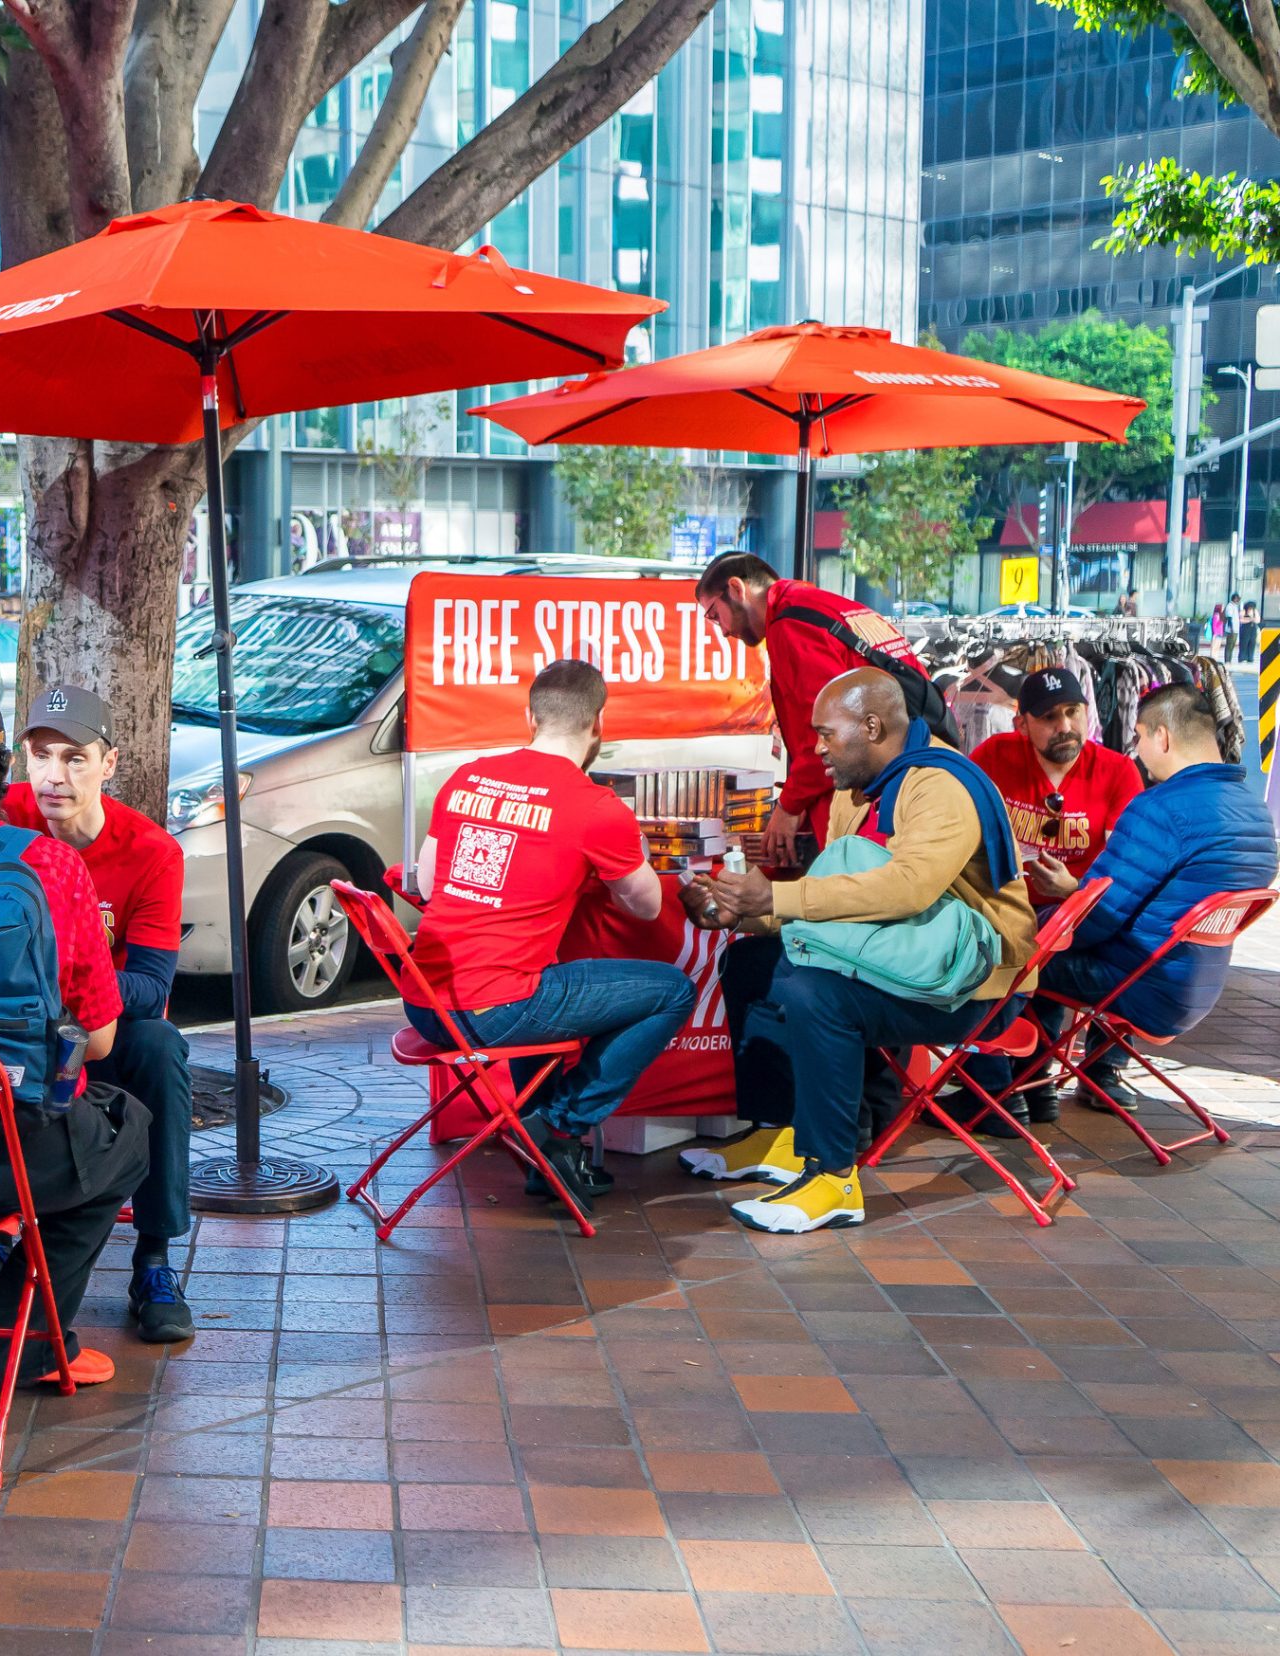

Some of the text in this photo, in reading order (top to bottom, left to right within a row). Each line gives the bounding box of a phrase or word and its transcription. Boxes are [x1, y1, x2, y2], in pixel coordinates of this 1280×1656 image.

[433, 598, 520, 686] FREE
[533, 600, 666, 684] STRESS
[476, 785, 530, 802] ABOUT YOUR
[480, 776, 529, 793] SOMETHING
[528, 786, 549, 797] NEW
[446, 789, 552, 832] MENTAL HEALTH
